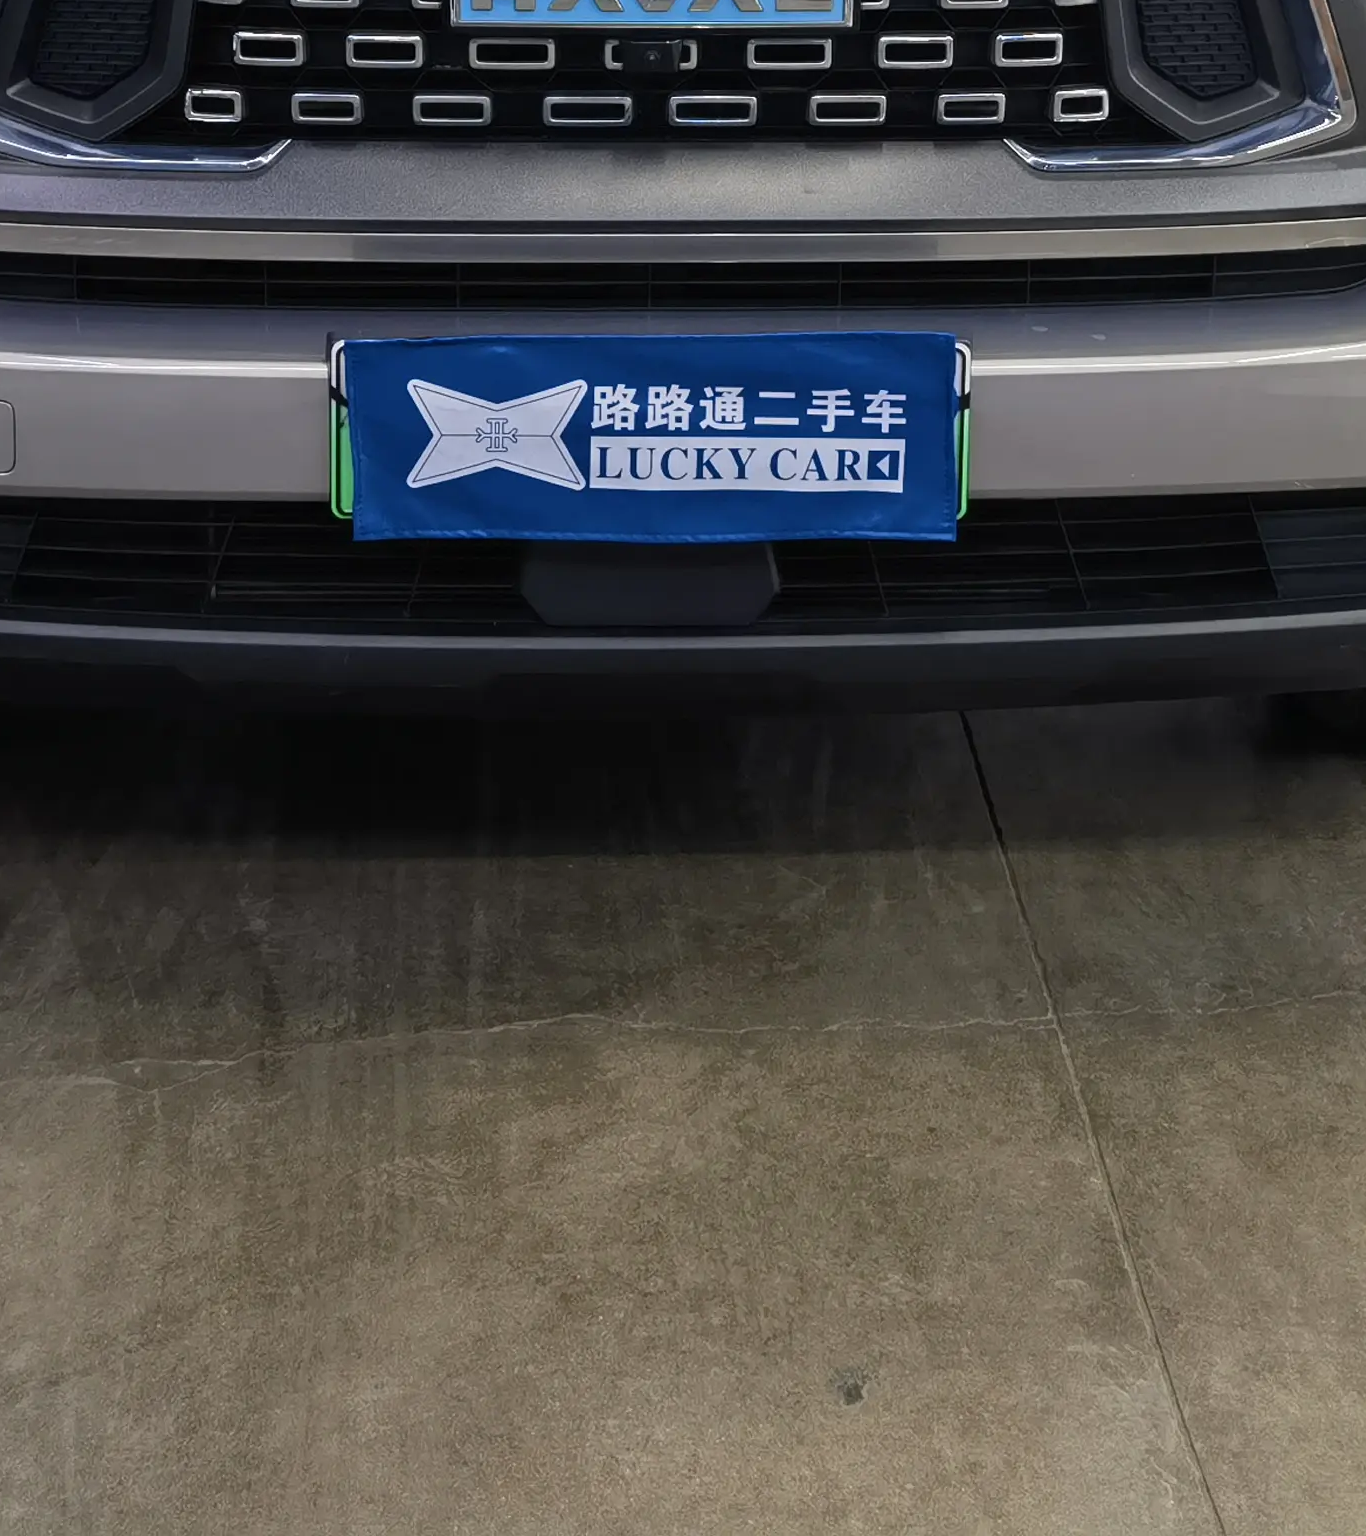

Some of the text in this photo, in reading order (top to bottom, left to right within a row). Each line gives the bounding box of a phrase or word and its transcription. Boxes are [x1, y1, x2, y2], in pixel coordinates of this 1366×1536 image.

[591, 384, 907, 433] 路路通二手车
[595, 446, 866, 482] LUCKY CAR
